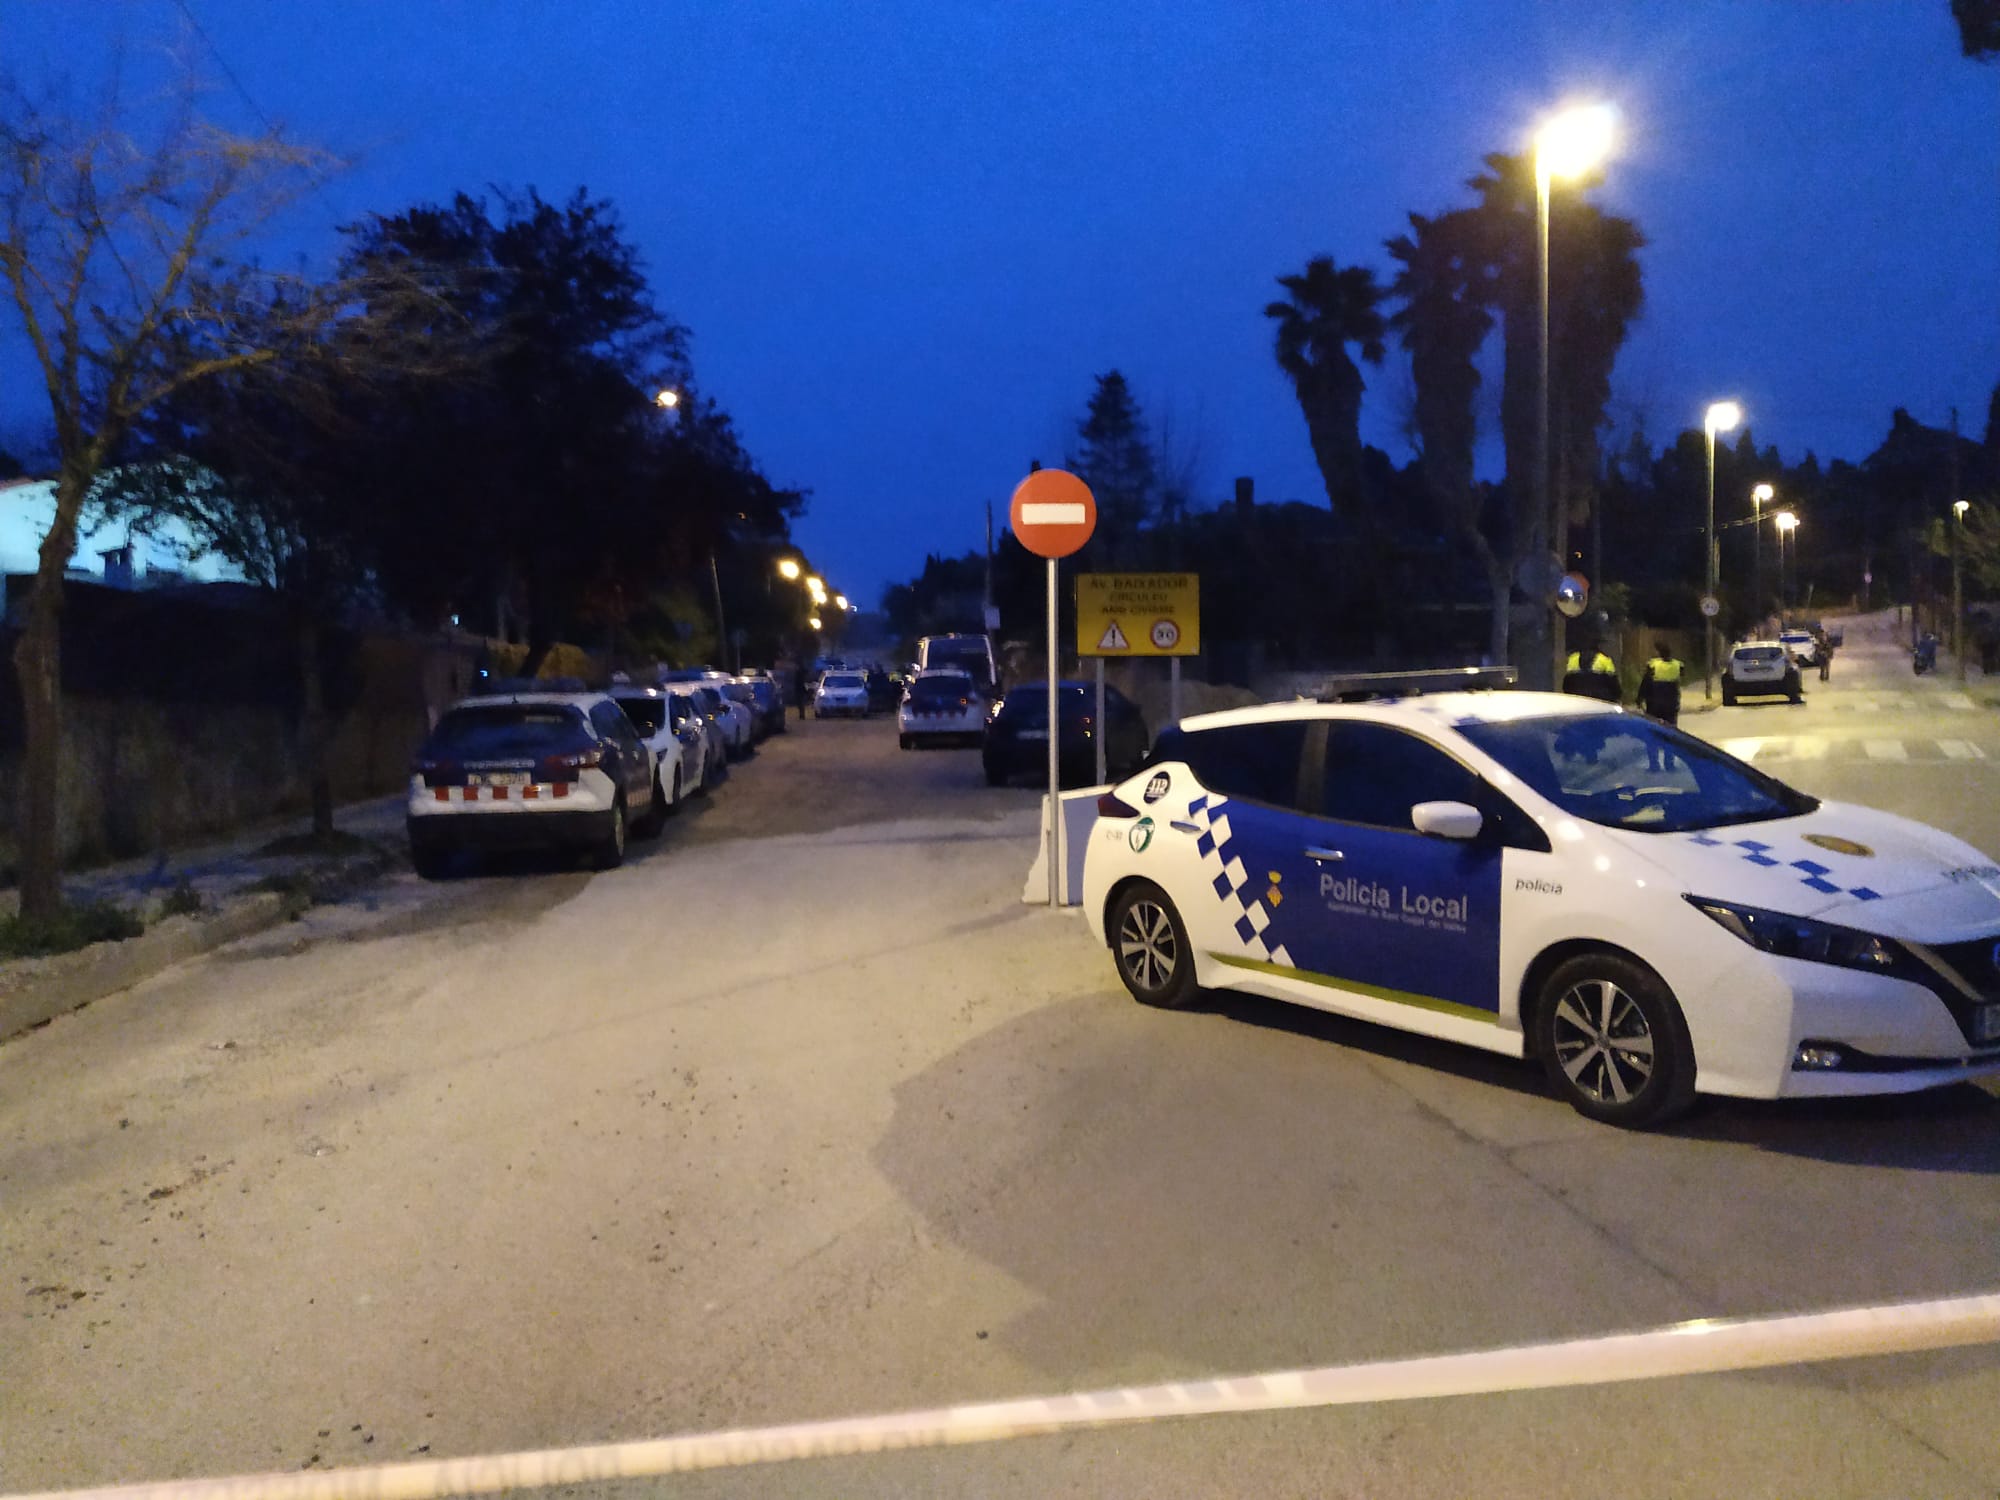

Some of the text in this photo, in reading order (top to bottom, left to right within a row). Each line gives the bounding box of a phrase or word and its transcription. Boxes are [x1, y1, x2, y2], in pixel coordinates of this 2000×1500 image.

[1320, 872, 1468, 922] Policia Local
[1515, 879, 1563, 896] policia
